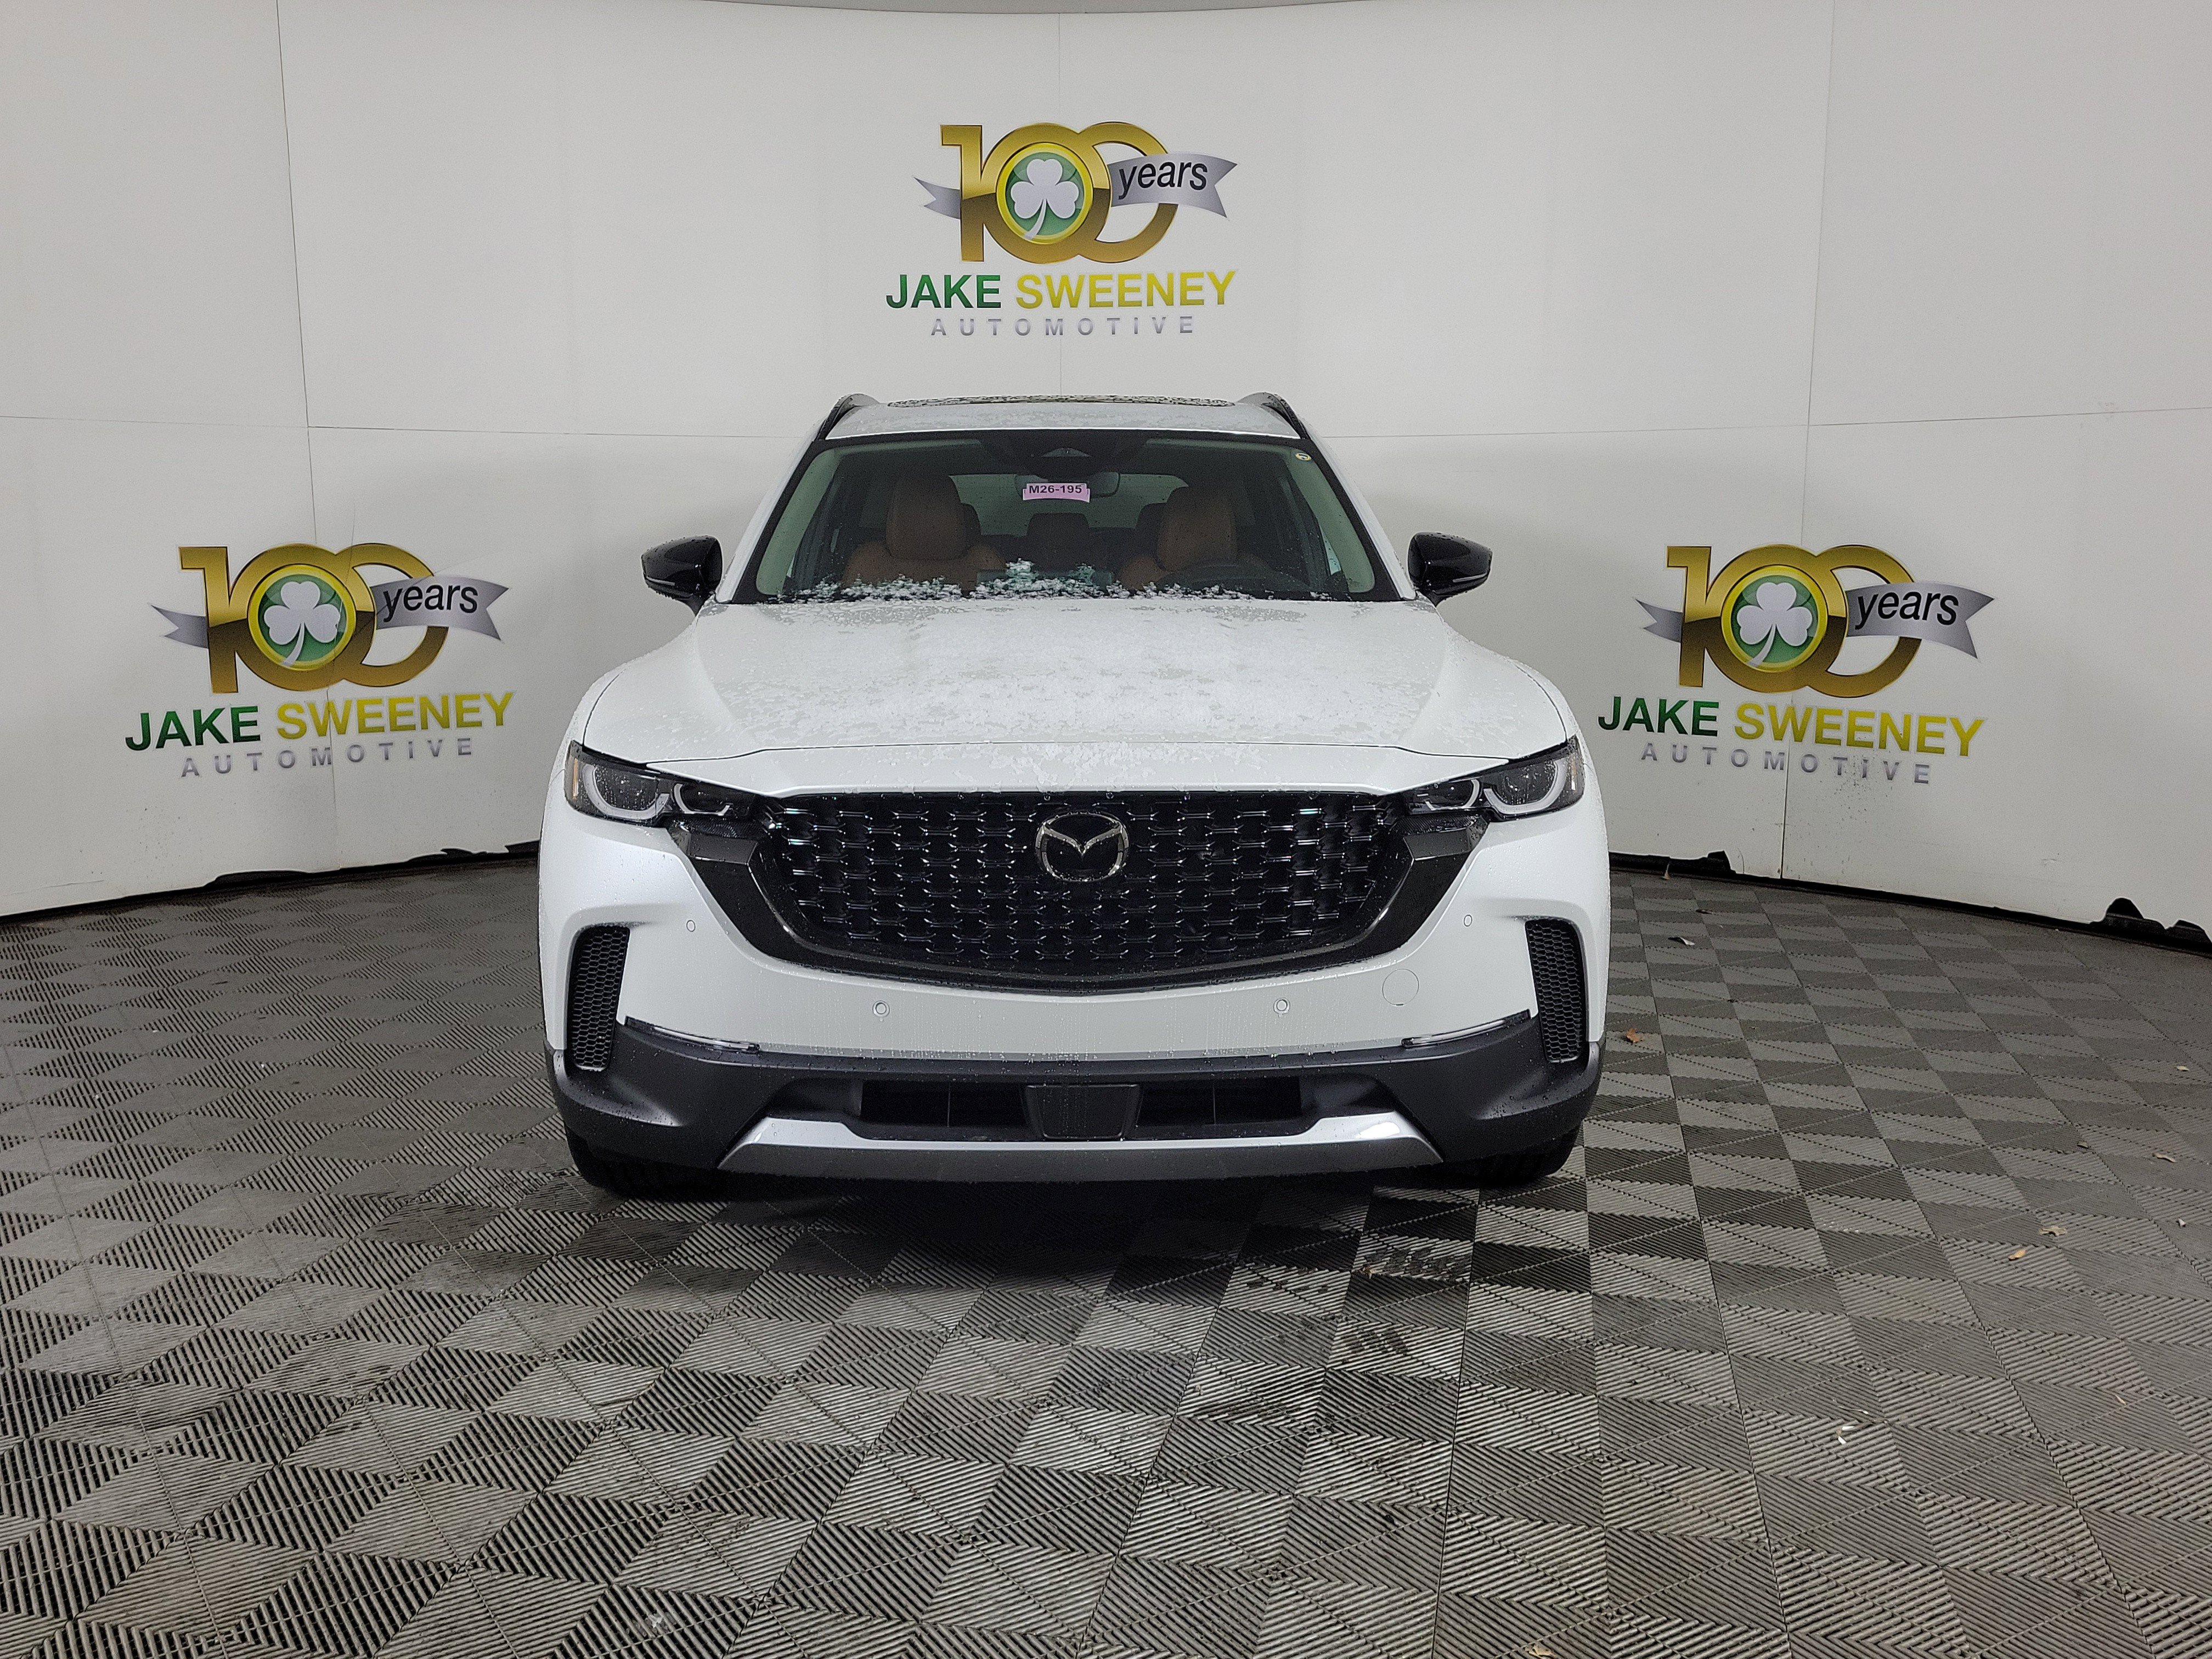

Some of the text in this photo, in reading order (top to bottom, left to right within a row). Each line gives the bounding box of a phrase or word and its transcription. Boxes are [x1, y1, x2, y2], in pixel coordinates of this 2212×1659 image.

[940, 121, 1207, 264] 100 years
[886, 270, 1236, 308] JAKE SWEENEY
[930, 315, 1193, 336] AUTOMOTIVE
[1029, 485, 1082, 493] M26-195
[178, 543, 479, 694] 100 years
[1666, 544, 1959, 698] 100 years
[125, 691, 514, 751] JAKE SWEENEY
[1598, 697, 1984, 757] JAKE SWEENEY
[181, 738, 472, 777] AUTOMOTIVE
[1641, 743, 1930, 784] AUTOMOTIVE
